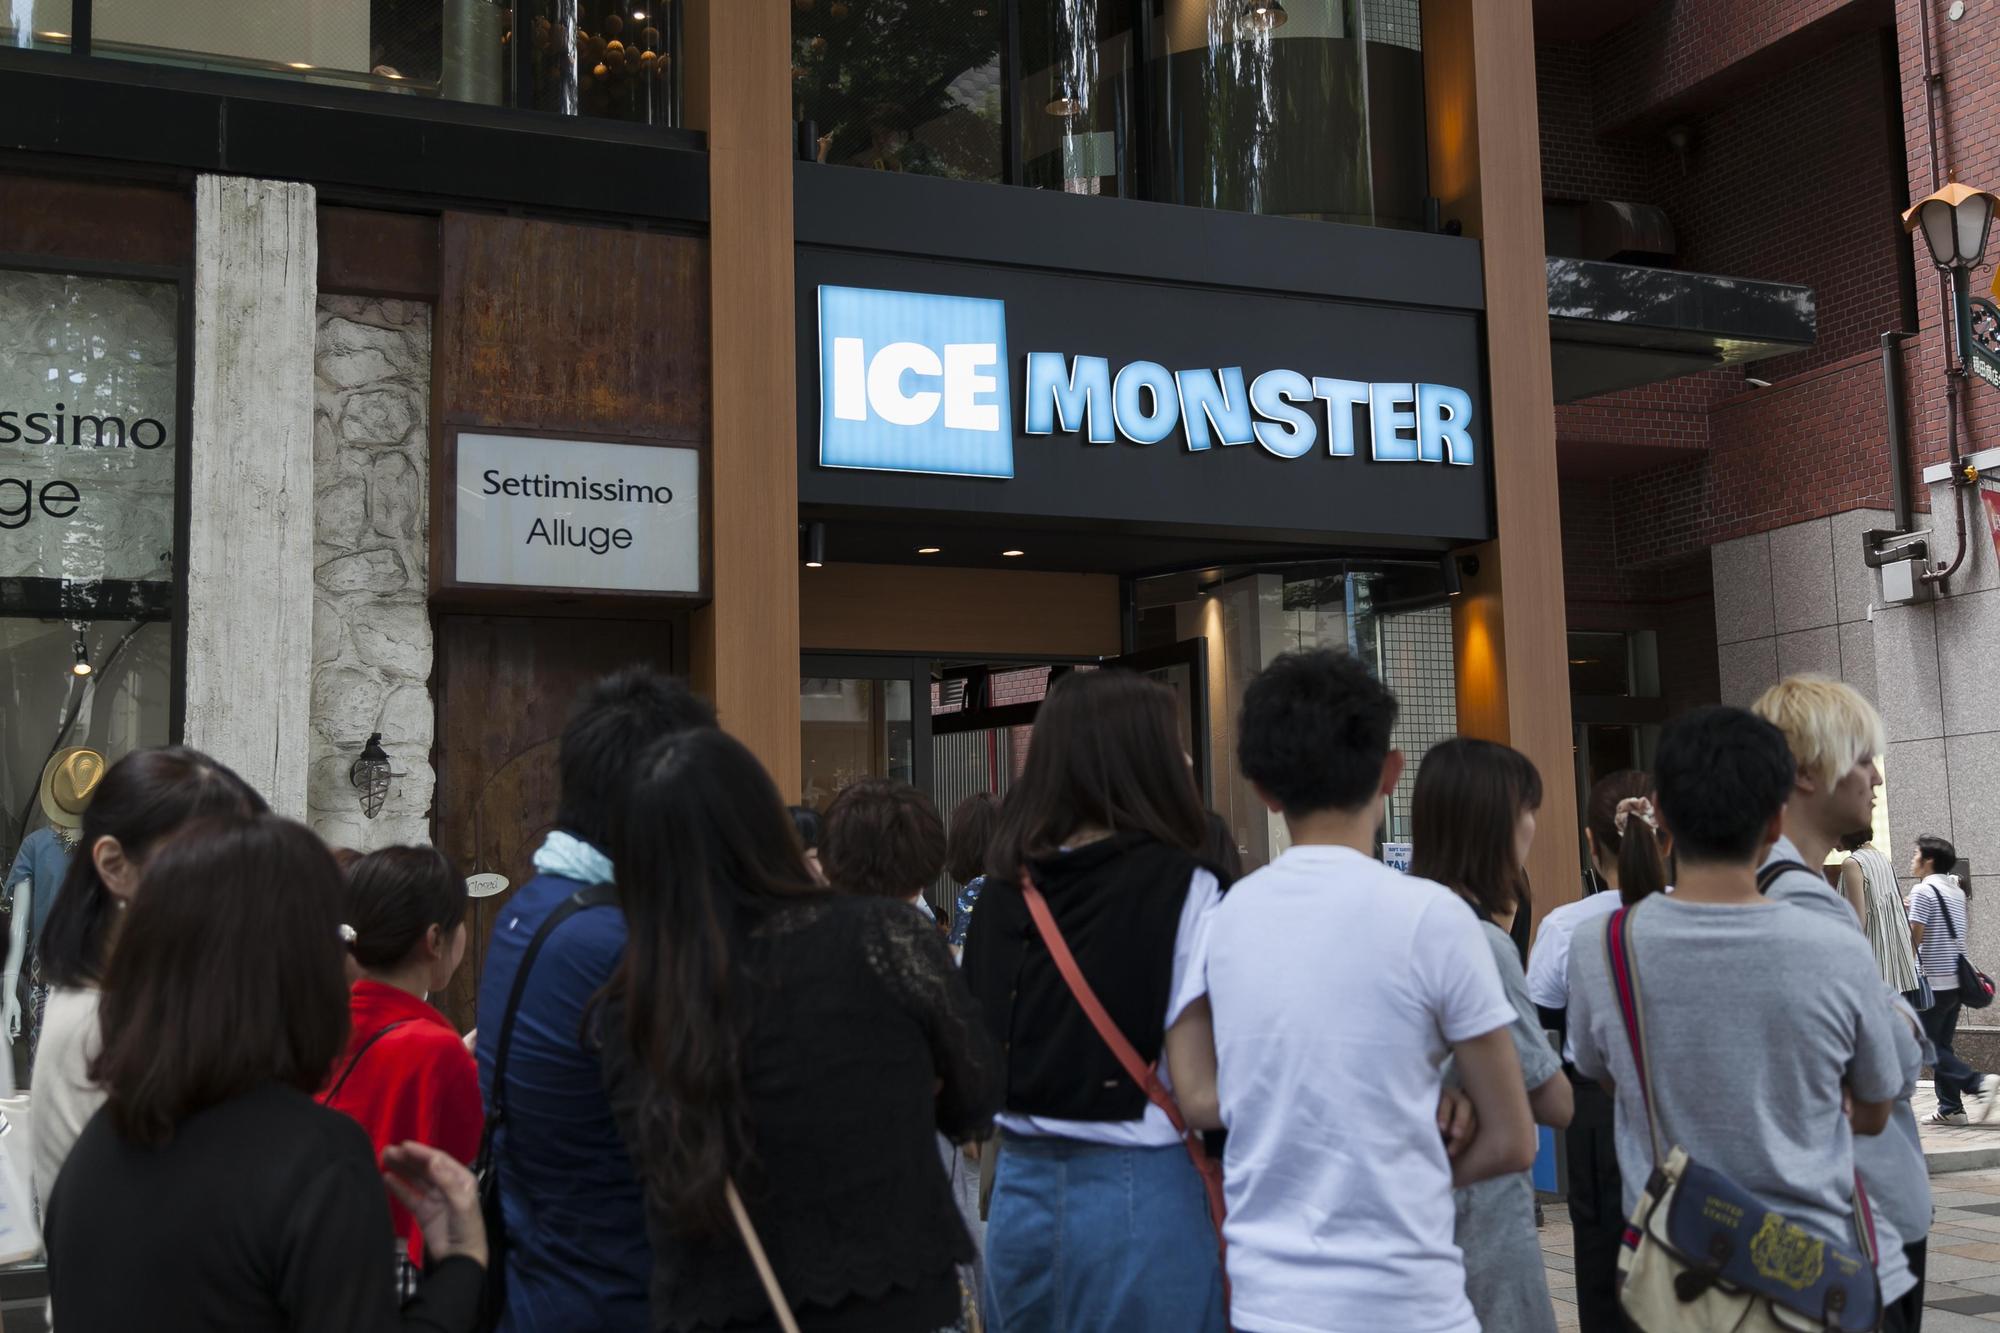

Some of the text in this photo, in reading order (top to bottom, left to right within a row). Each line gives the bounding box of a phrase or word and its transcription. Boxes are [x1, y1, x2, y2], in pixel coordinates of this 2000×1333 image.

[833, 337, 1474, 466] ICE MONSTER
[482, 469, 673, 504] Settimissimo
[526, 517, 633, 555] Alluge
